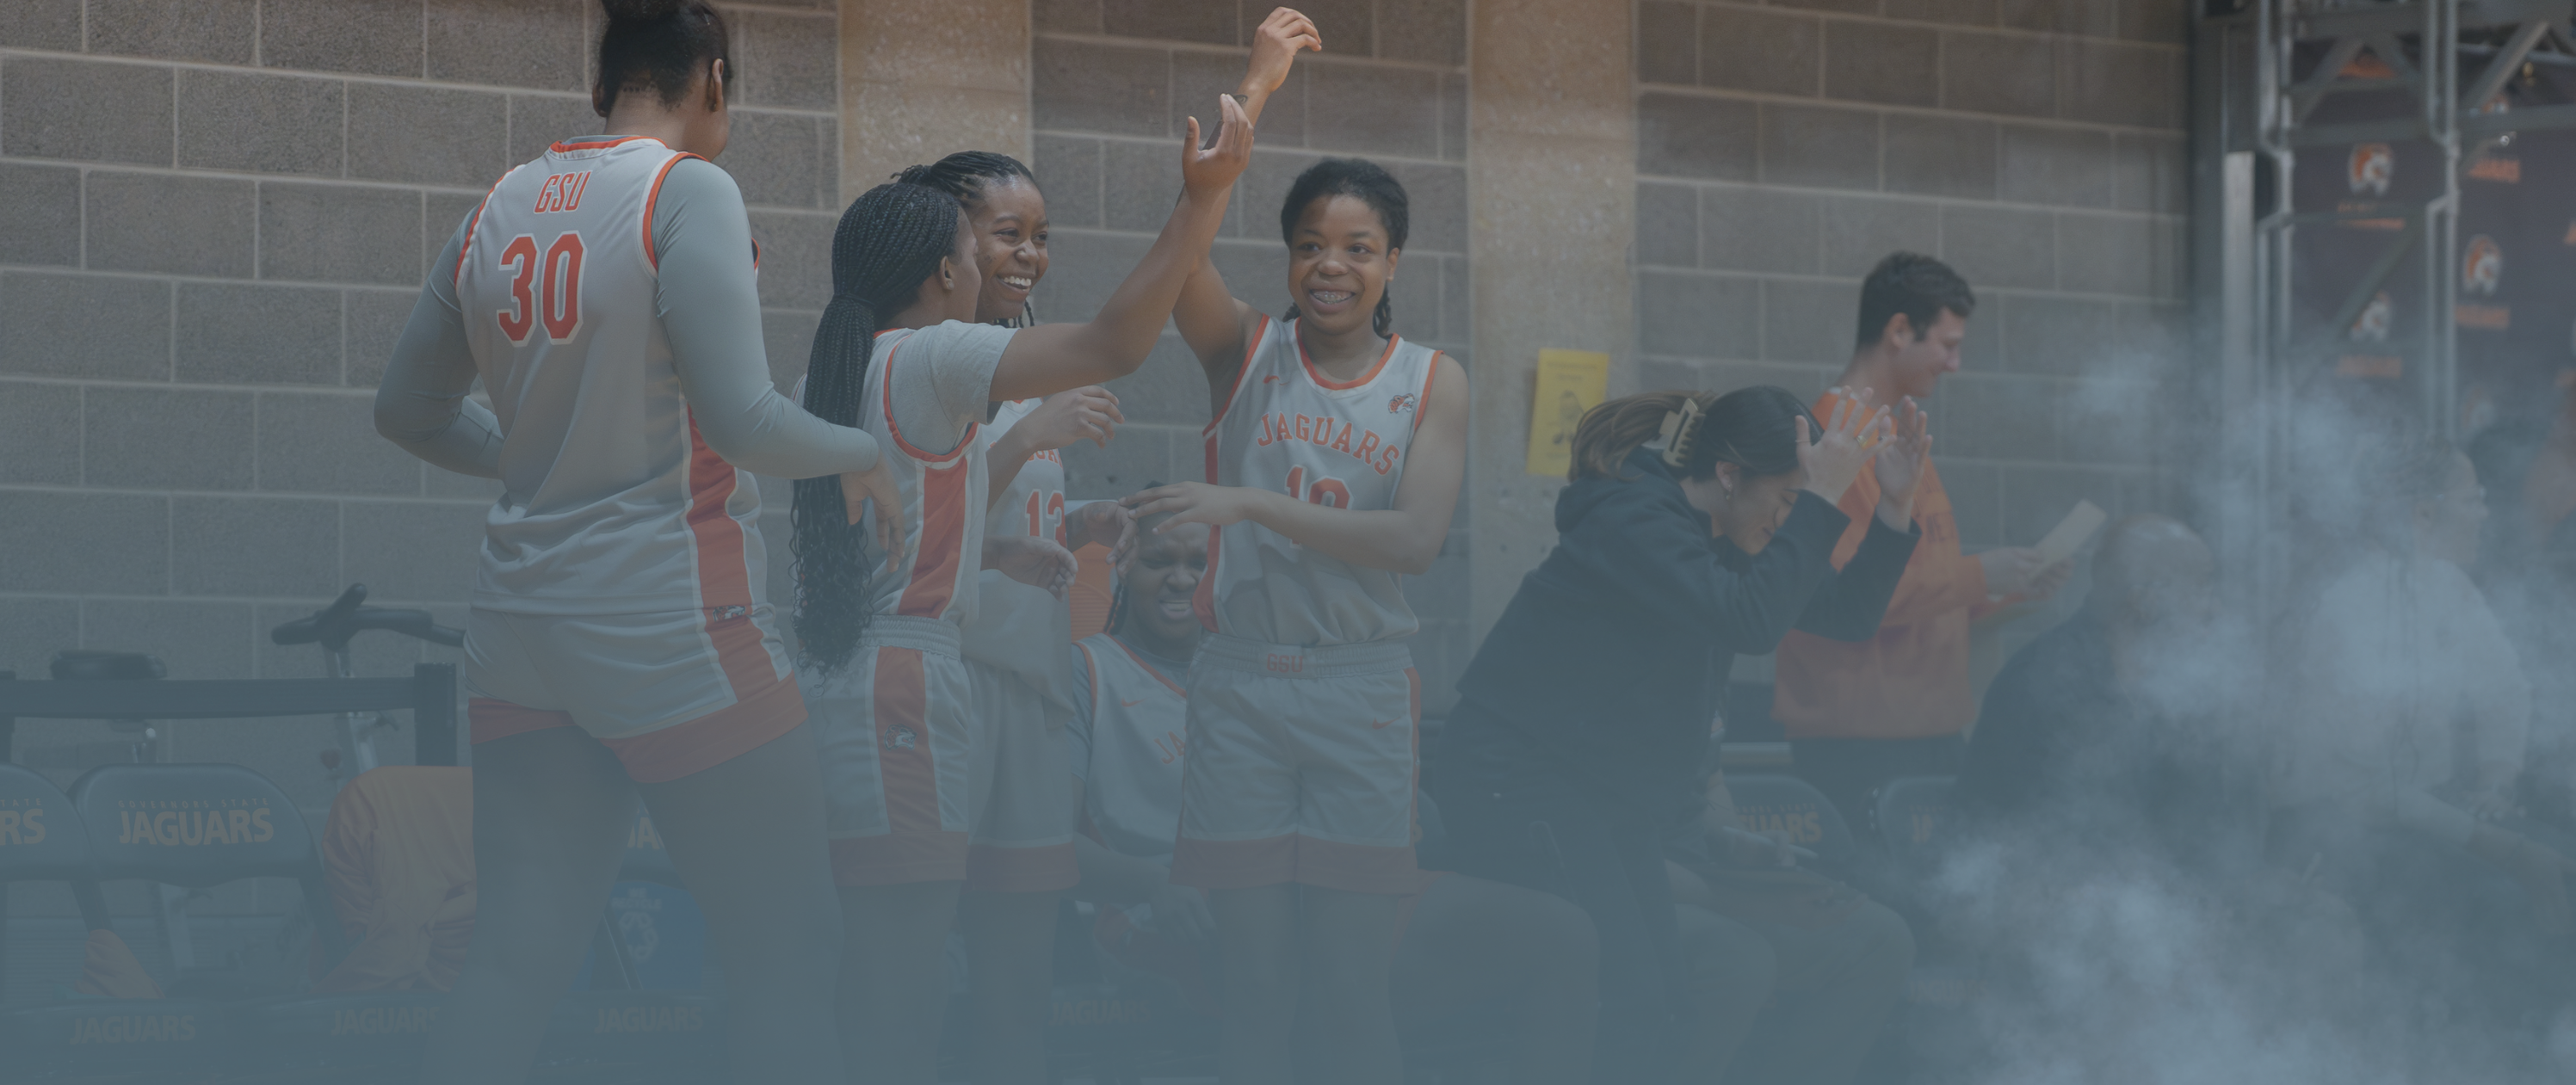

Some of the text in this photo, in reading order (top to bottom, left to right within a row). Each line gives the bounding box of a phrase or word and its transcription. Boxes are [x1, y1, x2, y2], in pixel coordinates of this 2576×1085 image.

[534, 171, 591, 213] GSU
[497, 231, 588, 347] 30
[1257, 412, 1400, 476] JAGUARS
[1267, 652, 1303, 674] GSU
[1153, 725, 1186, 765] JA
[118, 797, 269, 810] GOVERNORS STATE
[0, 808, 46, 847] RS
[118, 807, 275, 847] JAGUARS
[1739, 811, 1823, 844] UARS
[69, 1014, 197, 1046] JAGUARS
[594, 1005, 704, 1034] JAGUARS
[1047, 999, 1151, 1027] JAGUARS
